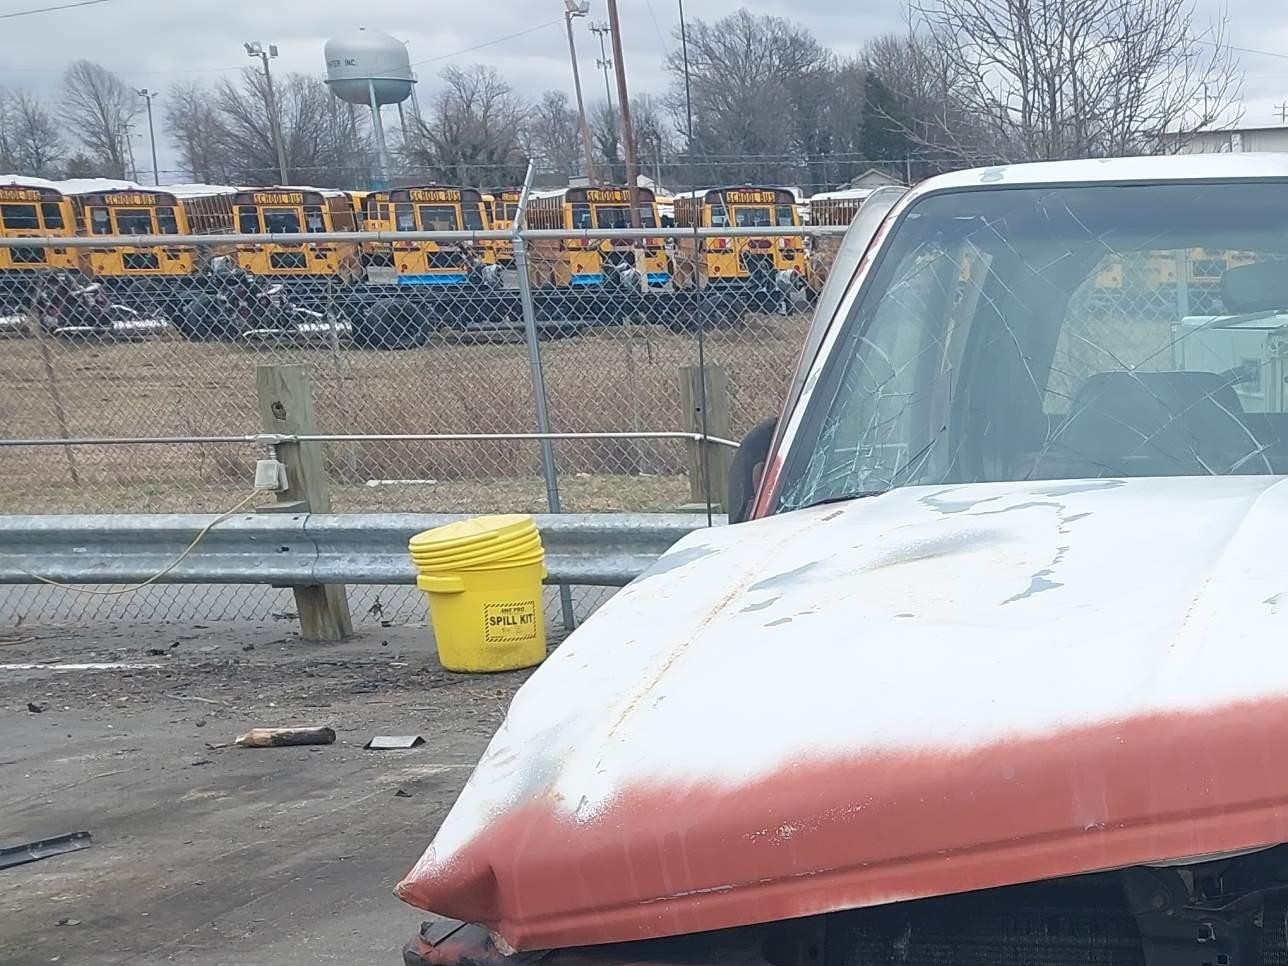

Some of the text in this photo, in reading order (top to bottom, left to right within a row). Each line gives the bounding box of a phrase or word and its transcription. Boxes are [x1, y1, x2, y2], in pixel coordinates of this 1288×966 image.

[104, 194, 156, 205] SCHOOL BUS
[254, 193, 304, 205] SCHOOL BUS
[410, 191, 461, 202] SCHOOL BUS
[587, 191, 632, 202] SCHOOL BU
[727, 191, 776, 203] SCHOOL BUS
[489, 614, 533, 626] SPILL KIT
